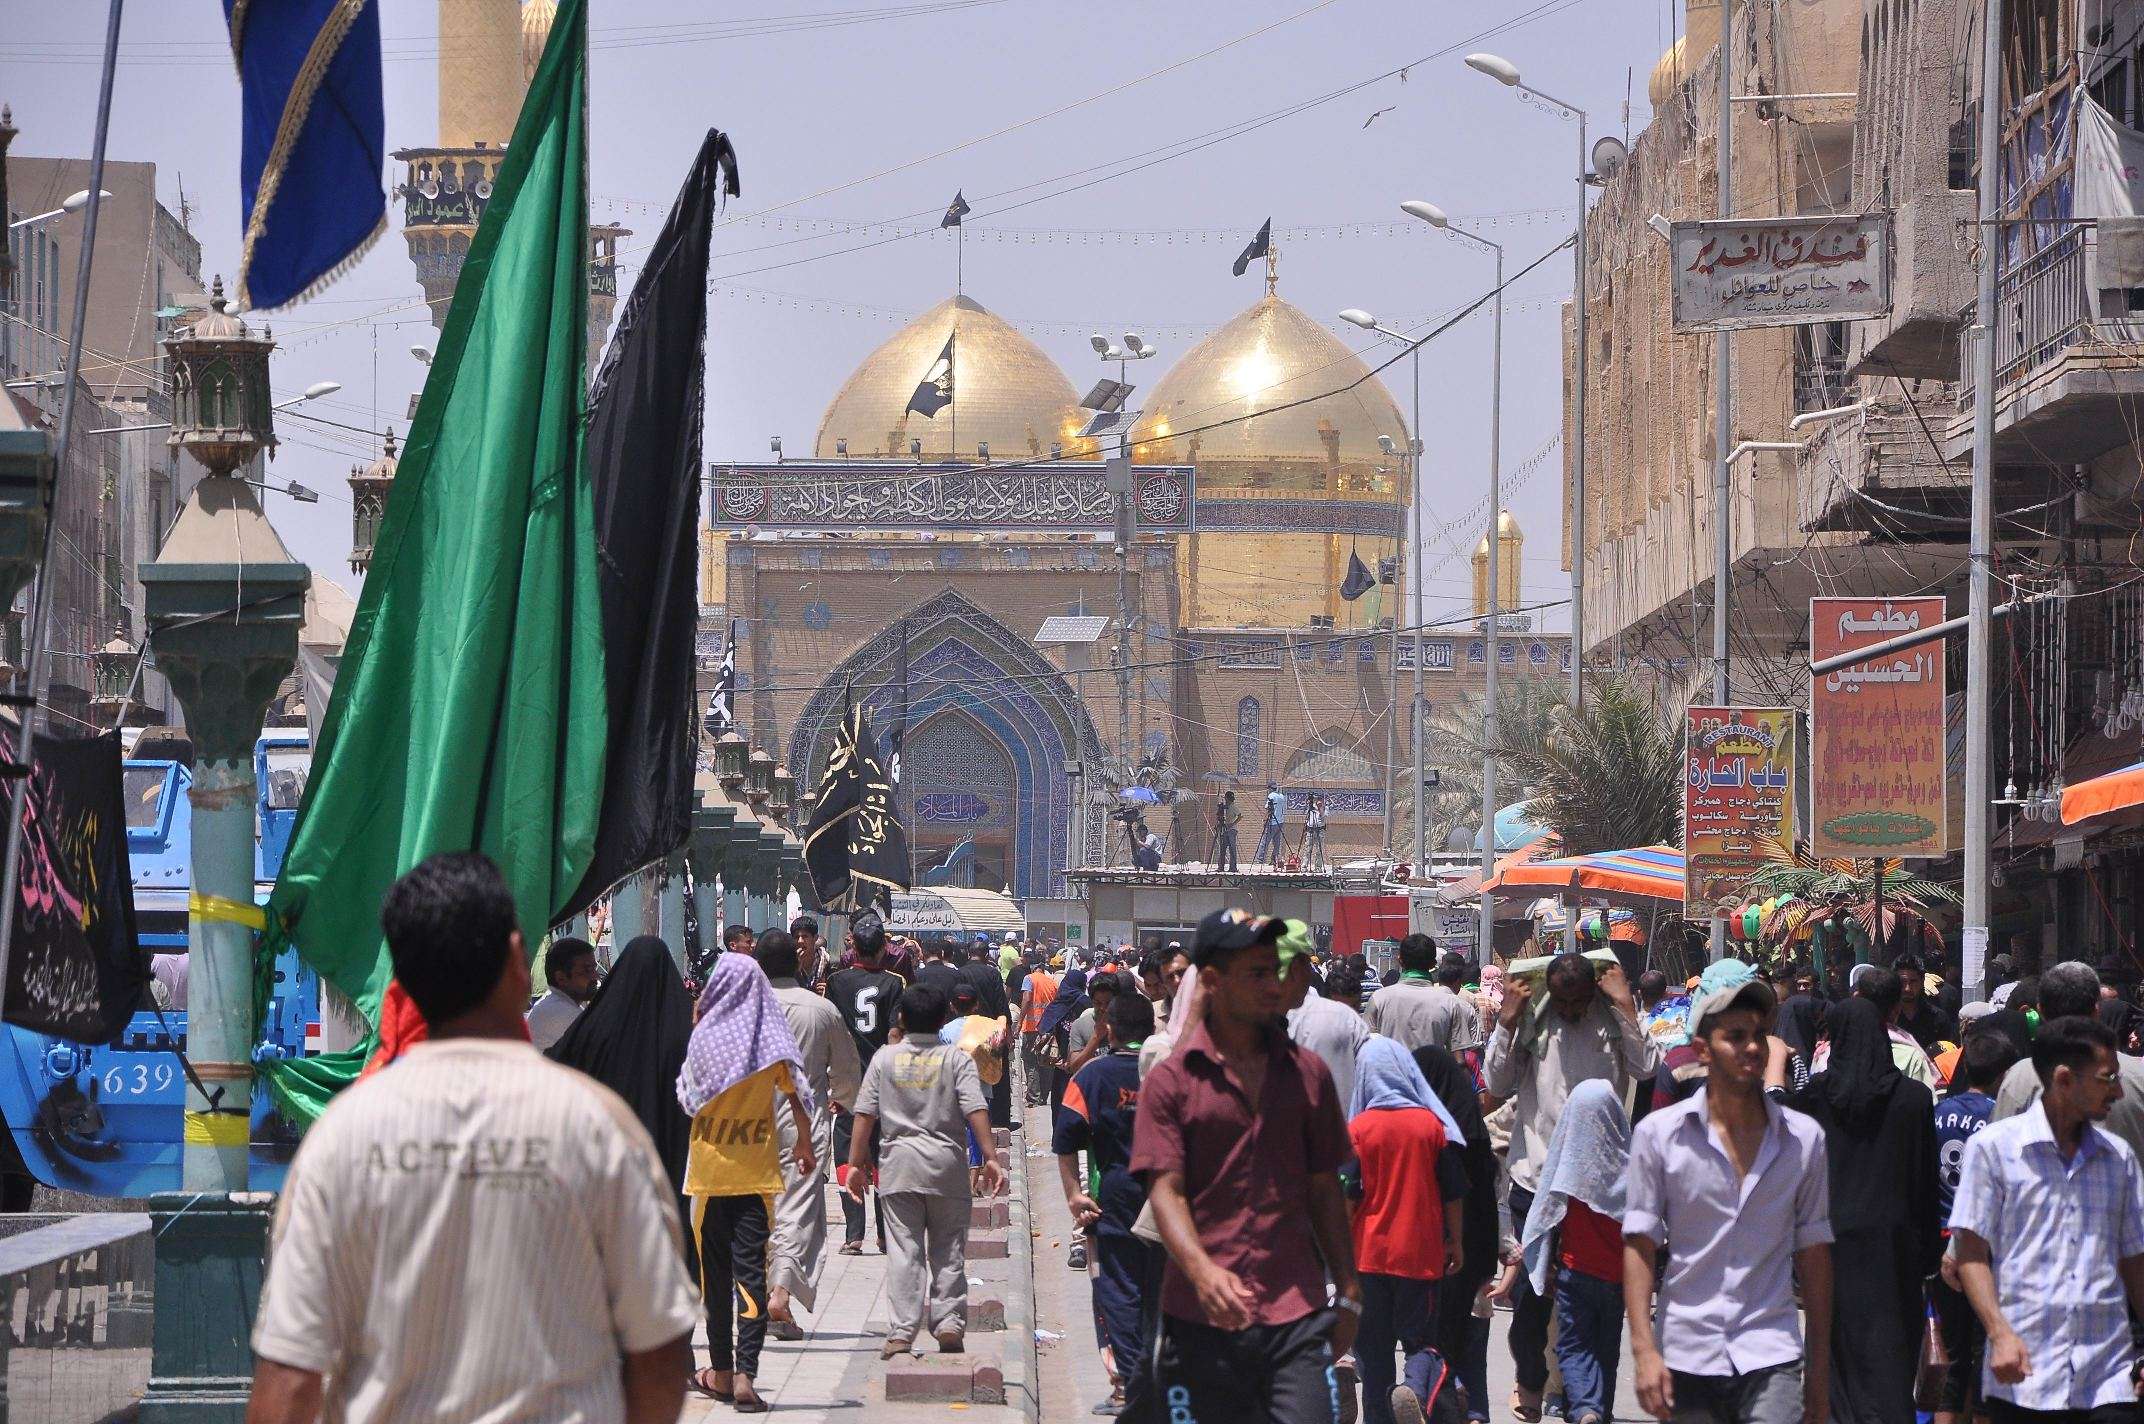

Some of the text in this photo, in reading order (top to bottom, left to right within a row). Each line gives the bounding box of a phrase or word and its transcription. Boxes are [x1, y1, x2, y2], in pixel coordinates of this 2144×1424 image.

[427, 199, 464, 224] عمود
[1686, 228, 1868, 277] فندق الغدير
[1783, 273, 1840, 298] خاص
[1839, 600, 1920, 642] مطعم
[1826, 652, 1933, 693] الحسين
[1703, 725, 1776, 748] RESTAURANT
[1715, 736, 1764, 759] مطعم
[1689, 757, 1745, 793] الحارة
[1749, 759, 1789, 794] باب
[1693, 796, 1782, 810] كنتاكي دجاج همبركر
[1691, 810, 1782, 822] شاورمة سكالوب
[1692, 824, 1722, 839] محشي
[1723, 826, 1747, 837] دجاج
[1722, 841, 1752, 853] بيتزا
[1702, 871, 1724, 883] مجاني
[1442, 914, 1470, 927] تفتيش
[855, 986, 879, 1033] 5
[104, 1064, 173, 1094] 639
[693, 1116, 769, 1145] NIKE
[368, 1135, 551, 1173] ACTIVE
